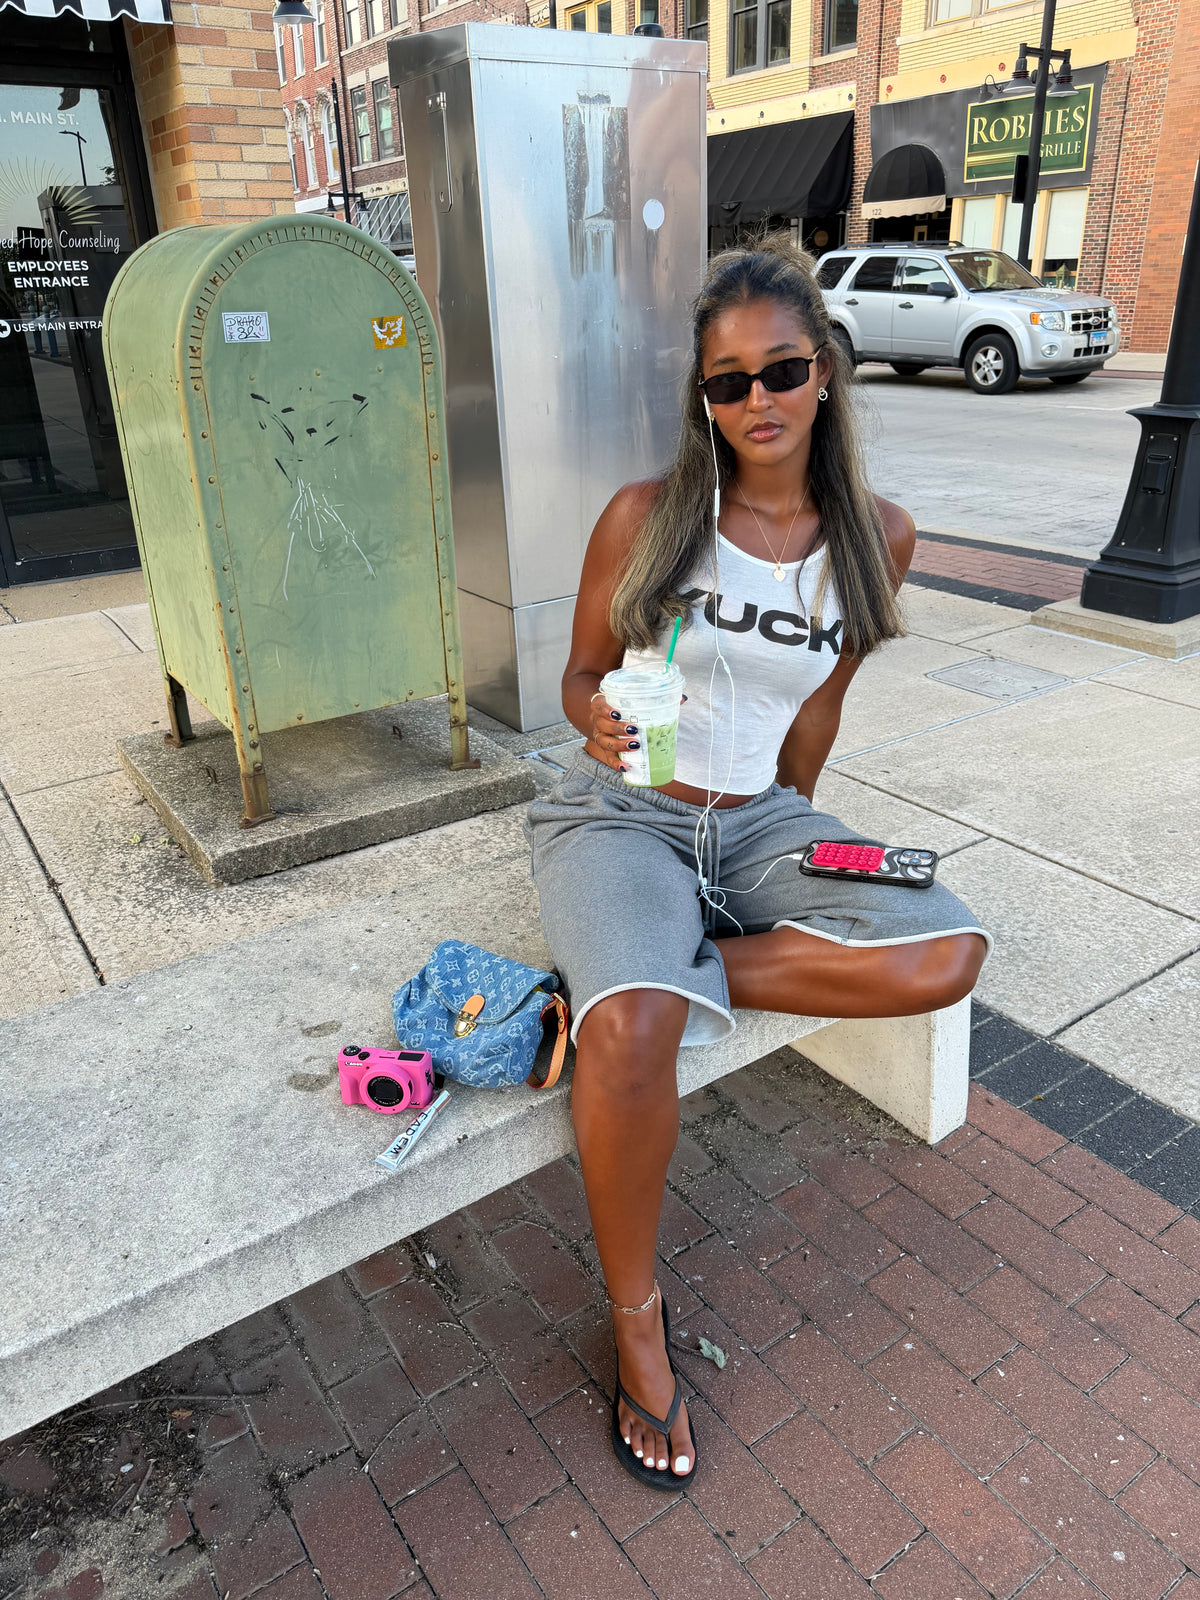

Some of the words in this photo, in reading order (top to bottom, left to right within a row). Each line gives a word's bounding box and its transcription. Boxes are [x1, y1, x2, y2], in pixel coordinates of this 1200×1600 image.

[10, 111, 53, 125] MAIN
[57, 113, 79, 126] ST.
[19, 230, 53, 255] Hope
[59, 229, 120, 254] Counseling
[7, 260, 89, 273] EMPLOYEES
[13, 276, 90, 289] ENTRANCE
[13, 323, 36, 333] USE
[38, 321, 66, 331] MAIN
[390, 1111, 428, 1155] EADEM
